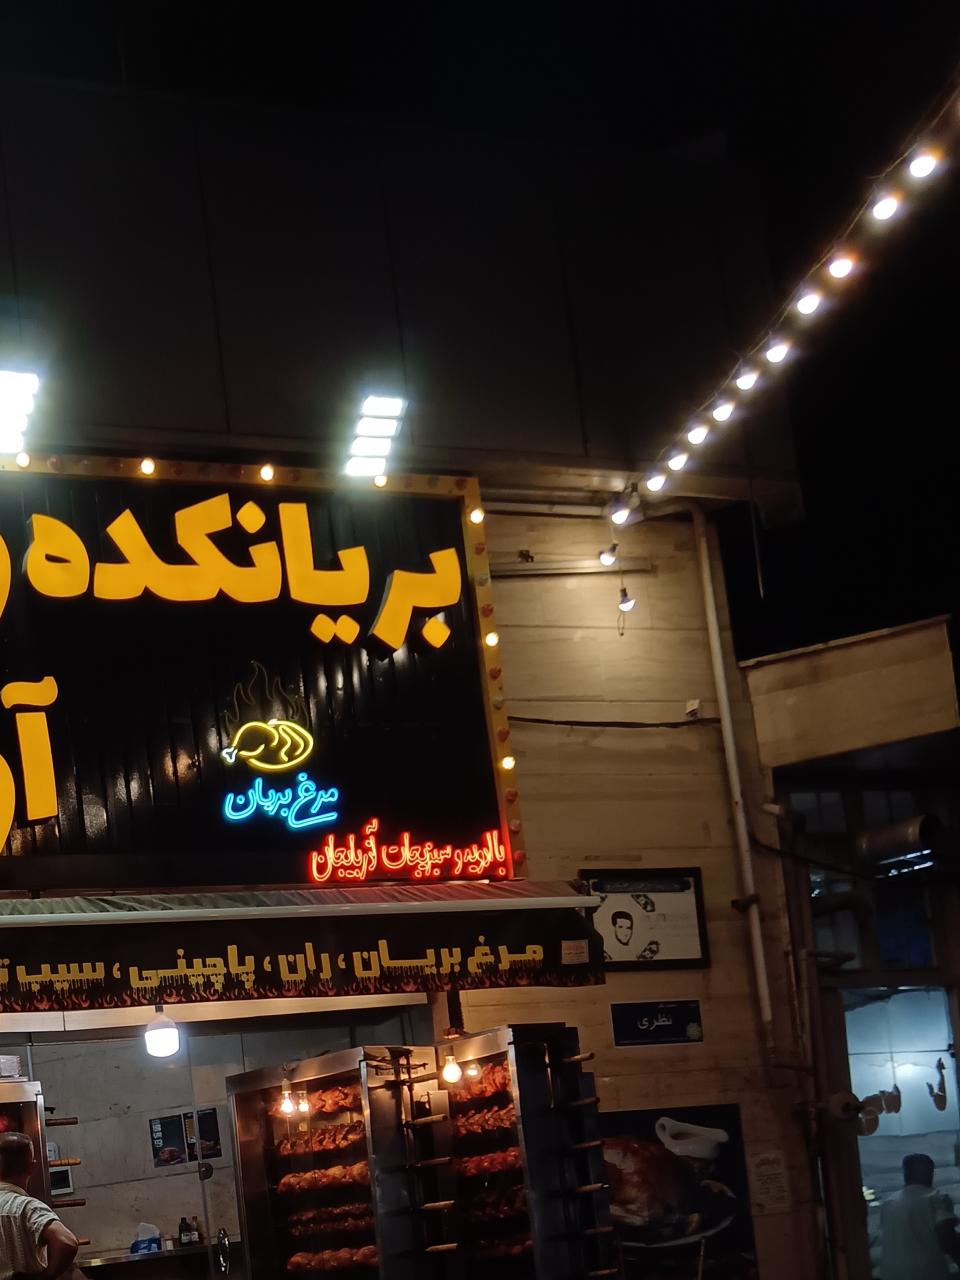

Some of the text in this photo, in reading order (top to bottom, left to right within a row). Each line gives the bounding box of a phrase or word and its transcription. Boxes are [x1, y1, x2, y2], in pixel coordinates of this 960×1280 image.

[22, 492, 462, 651] بریانکده
[225, 774, 340, 831] مرغ بریان
[17, 962, 104, 992] سیب
[467, 935, 544, 974] مرغ
